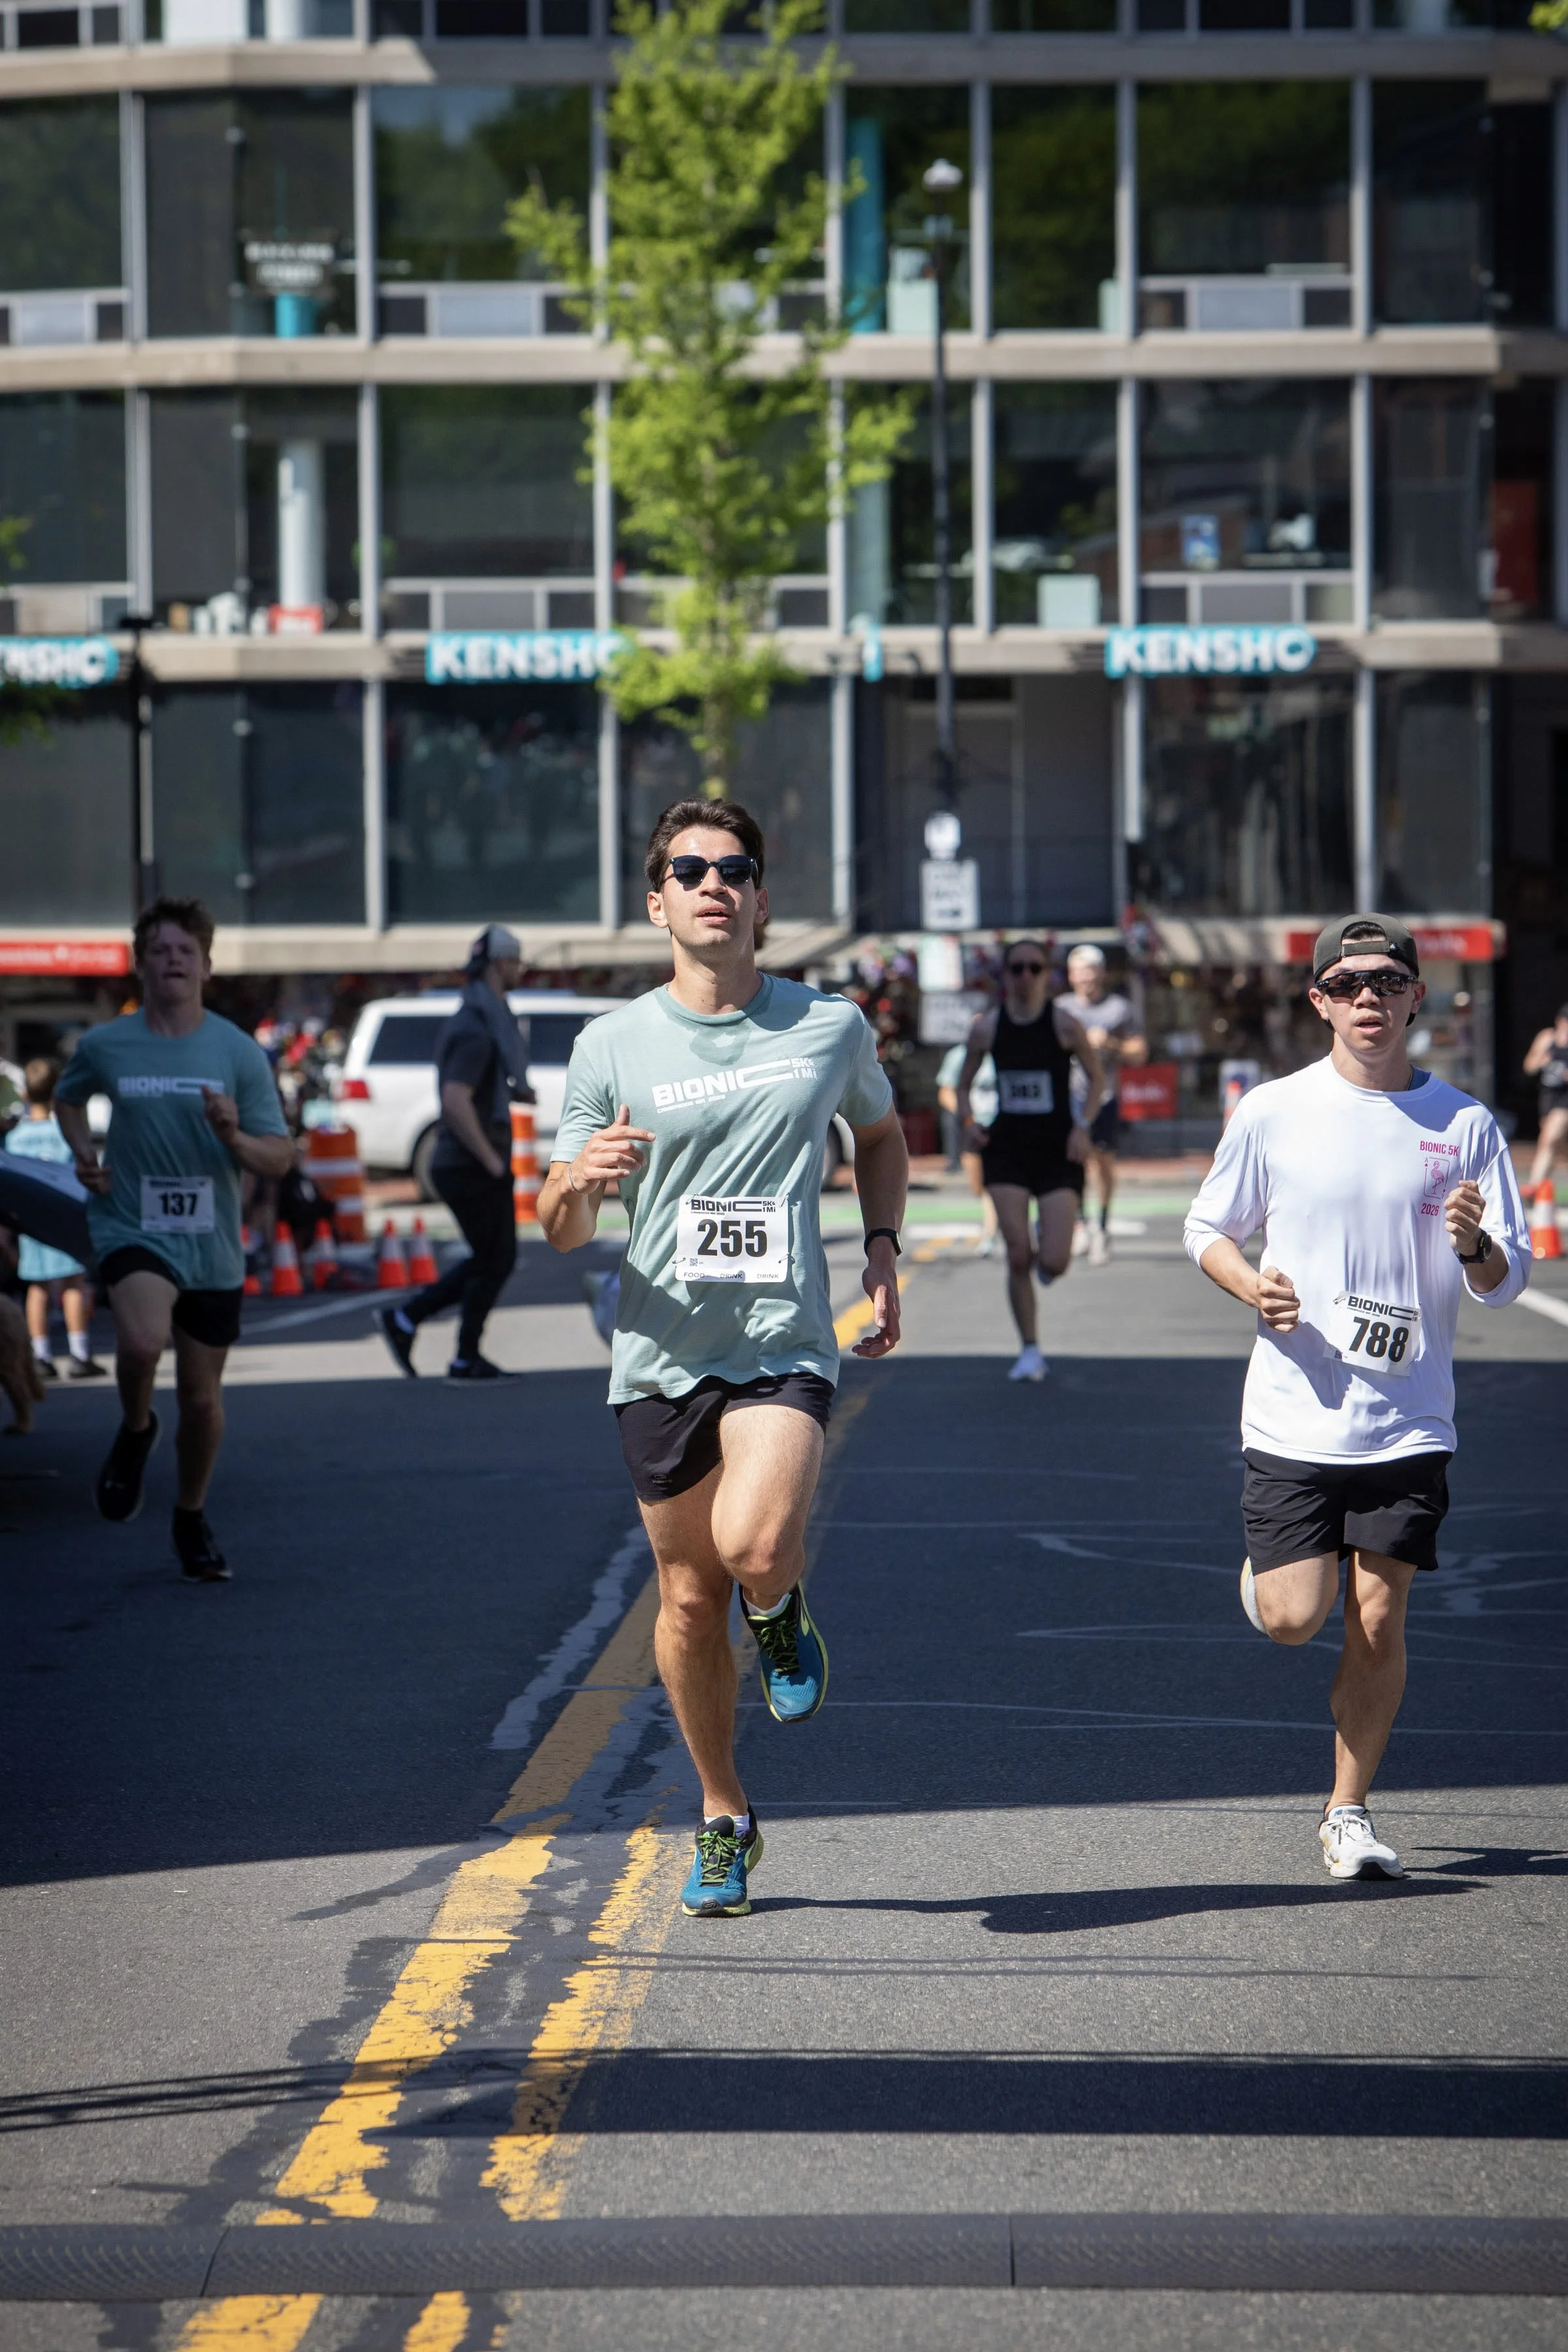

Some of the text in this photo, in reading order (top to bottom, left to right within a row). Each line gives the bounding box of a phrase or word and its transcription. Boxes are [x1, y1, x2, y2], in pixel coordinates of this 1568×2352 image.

[1107, 625, 1317, 676] KENSHO
[652, 1059, 794, 1107] BIONIC
[1420, 1141, 1460, 1156] BIONIC 5K
[159, 1192, 197, 1217] 137
[691, 1199, 762, 1212] BIONIC
[1421, 1203, 1439, 1216] 2026
[697, 1218, 768, 1258] 255
[1348, 1296, 1414, 1321] BIONIC
[1348, 1316, 1409, 1363] 788
